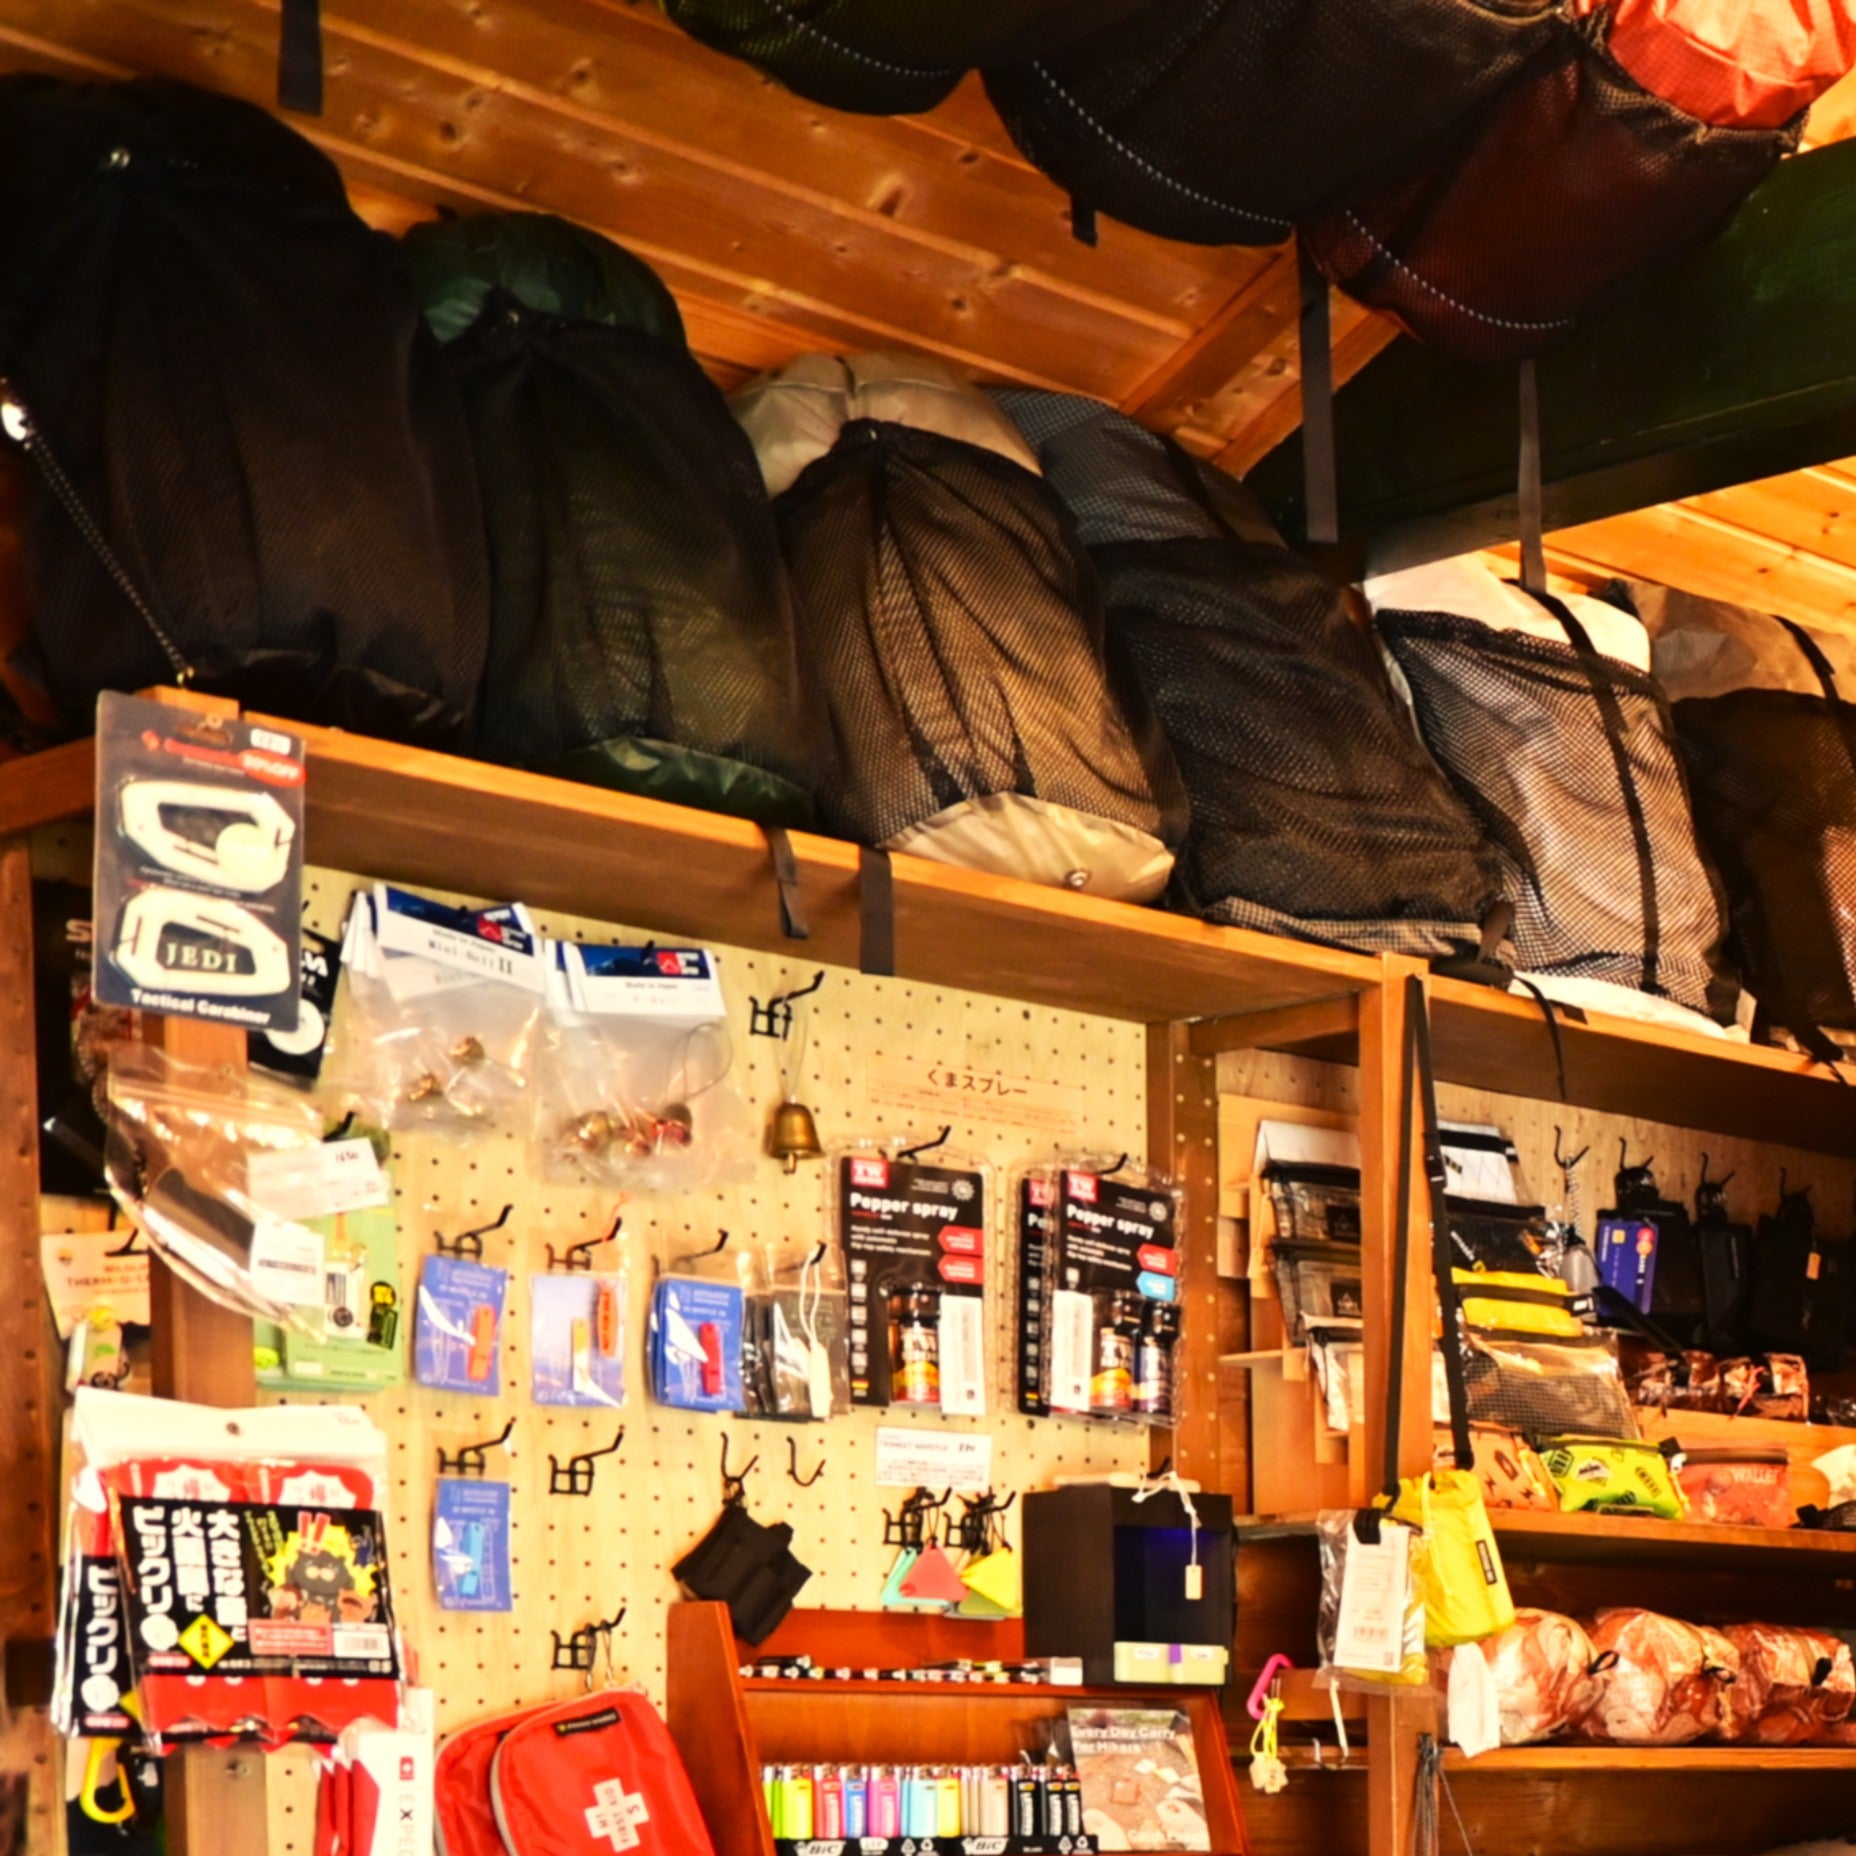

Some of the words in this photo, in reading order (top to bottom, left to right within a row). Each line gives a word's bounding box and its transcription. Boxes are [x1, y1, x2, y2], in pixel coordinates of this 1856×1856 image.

[165, 942, 237, 972] JEDI
[130, 987, 195, 1013] Tactical
[927, 1068, 1028, 1096] くまスプレー
[850, 1192, 910, 1214] Pepper
[912, 1202, 959, 1222] spray
[1066, 1203, 1115, 1228] Pepper
[1116, 1219, 1155, 1240] spray
